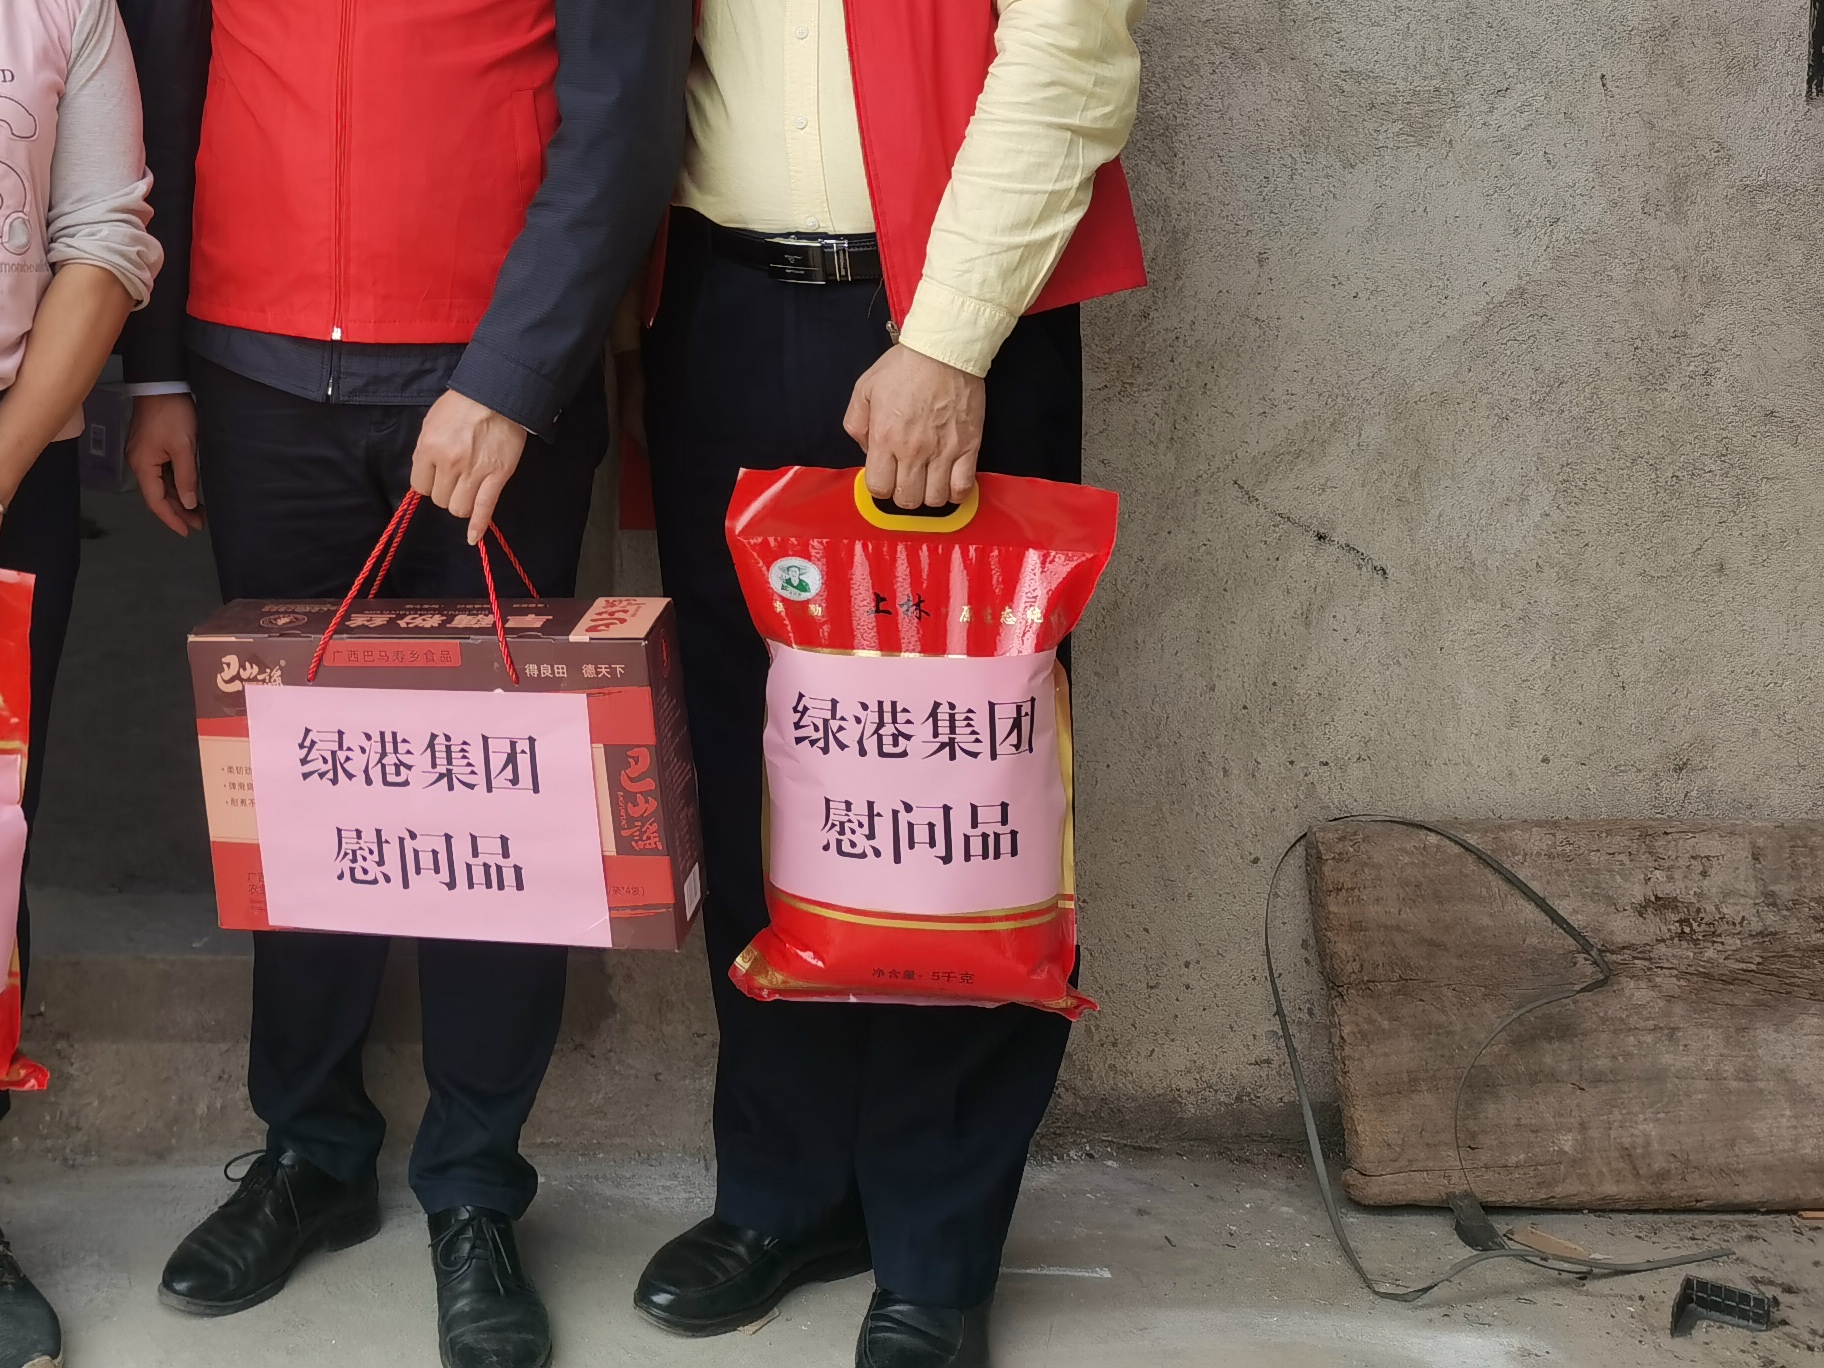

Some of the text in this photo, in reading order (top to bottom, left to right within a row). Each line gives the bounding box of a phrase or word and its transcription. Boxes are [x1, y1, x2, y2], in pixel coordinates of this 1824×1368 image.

[866, 592, 931, 622] 上林
[332, 649, 452, 664] 广西巴马寿乡食品
[524, 663, 625, 678] 得良田 德天下
[296, 724, 542, 795] 绿港集团
[790, 690, 1037, 763] 绿港集团
[333, 825, 526, 892] 慰问品
[819, 795, 1020, 866] 慰问品
